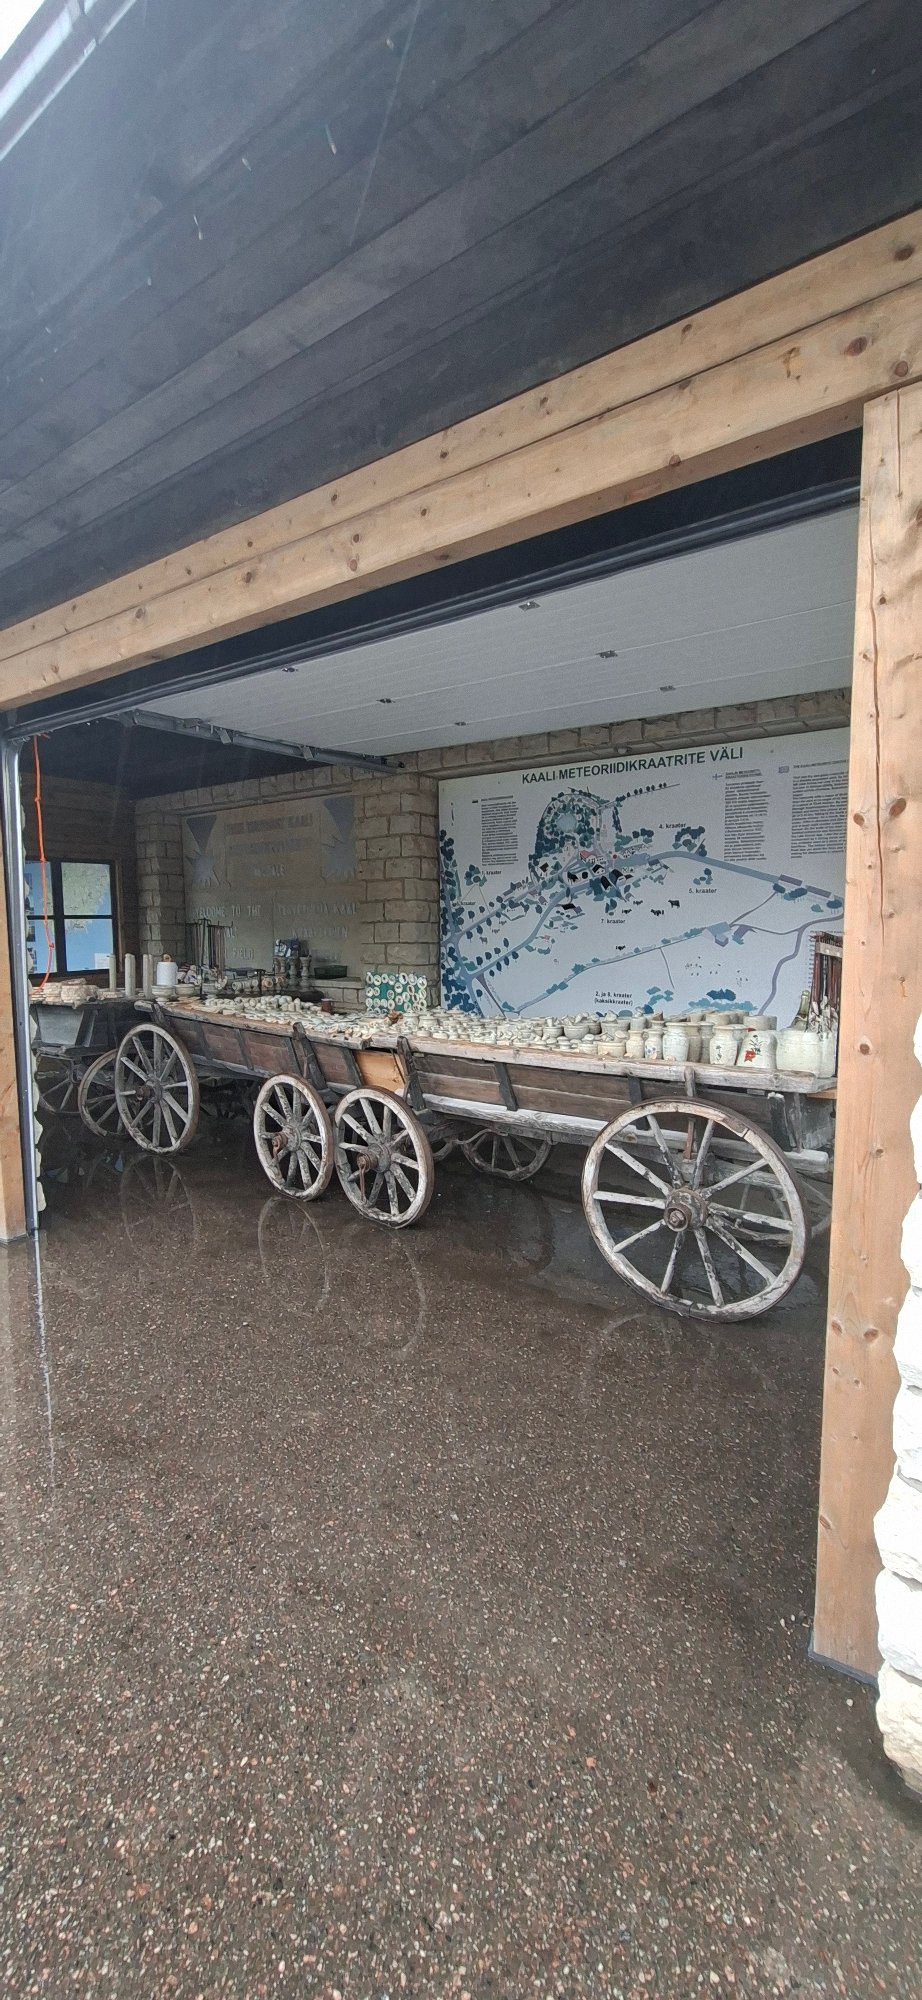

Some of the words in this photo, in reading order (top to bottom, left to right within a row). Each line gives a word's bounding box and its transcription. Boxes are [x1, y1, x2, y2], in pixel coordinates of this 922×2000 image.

[522, 770, 556, 784] KAALI
[558, 751, 706, 780] METEORIIDIKRAATRITE
[710, 746, 743, 762] VÄLI
